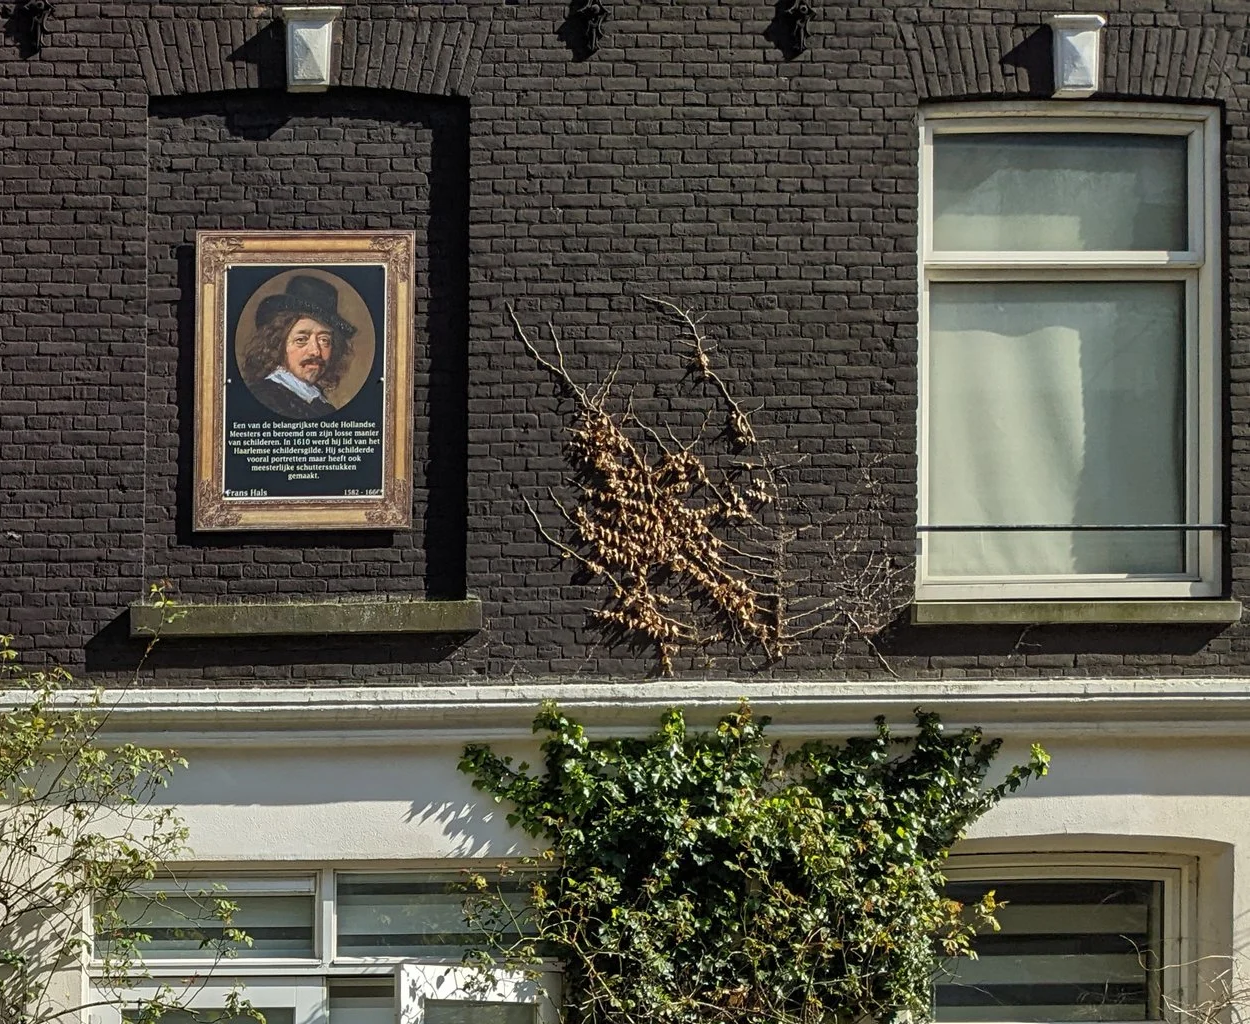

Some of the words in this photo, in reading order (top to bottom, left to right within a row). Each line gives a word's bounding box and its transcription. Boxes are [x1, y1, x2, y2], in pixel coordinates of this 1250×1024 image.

[233, 421, 246, 429] Een
[262, 421, 271, 429] de
[273, 421, 319, 430] belangrijkste
[320, 421, 339, 429] Oude
[229, 430, 261, 438] Meesters
[319, 430, 333, 438] zijn
[335, 429, 353, 437] losse
[354, 429, 379, 437] manier
[243, 438, 282, 446] schilderen.
[331, 438, 341, 446] hij
[272, 446, 324, 455] schildersgilde.
[325, 446, 336, 455] Hij
[337, 446, 375, 454] schilderde
[271, 456, 307, 464] portretten
[251, 464, 295, 472] meesterlijke
[296, 463, 357, 471] schuttersstukken
[288, 472, 320, 480] gemaakt.
[250, 488, 268, 496] Hals
